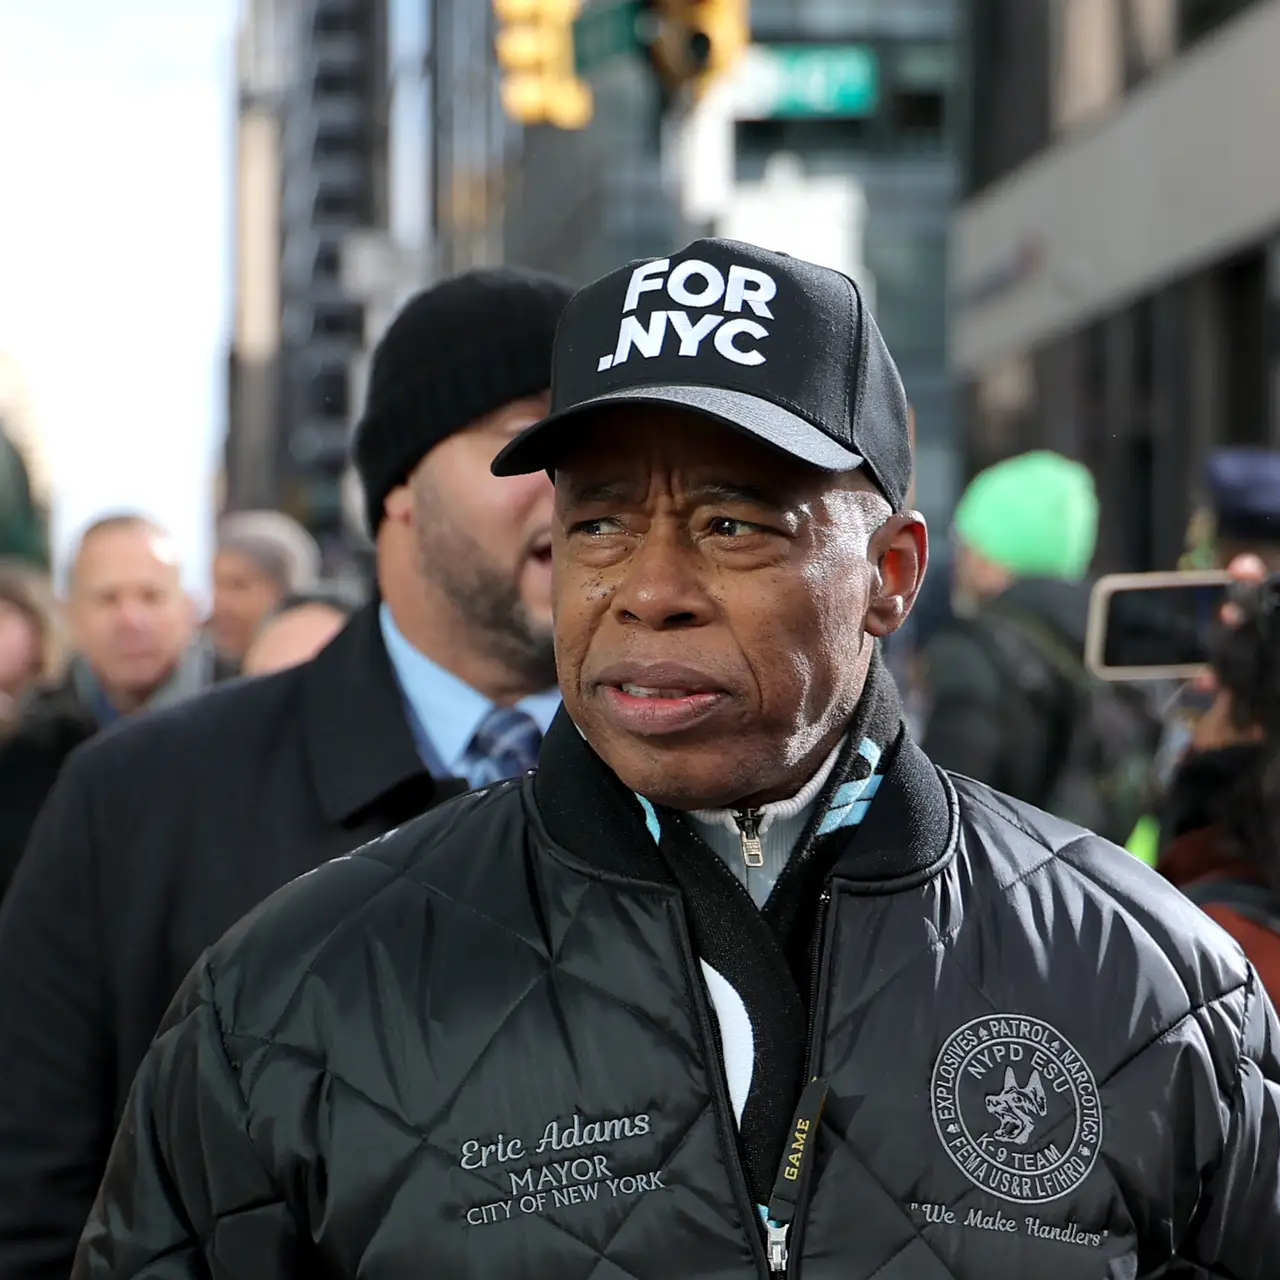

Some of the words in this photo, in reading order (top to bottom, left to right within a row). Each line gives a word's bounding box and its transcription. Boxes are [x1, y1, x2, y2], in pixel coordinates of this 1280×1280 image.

[622, 258, 777, 320] FOR
[596, 310, 770, 372] .NYC
[989, 1020, 1050, 1047] PATROL
[935, 1029, 979, 1120] EXPLOSIVES
[967, 1045, 1023, 1080] NYPD
[1030, 1052, 1070, 1093] ESU
[1059, 1050, 1100, 1144] NARCOTICS
[460, 1134, 525, 1170] Eric
[536, 1114, 651, 1153] Adams
[784, 1118, 810, 1180] GAME
[948, 1138, 986, 1182] FEMA
[989, 1175, 1032, 1198] US&R
[1035, 1155, 1087, 1198] LF/HRD
[976, 1133, 1008, 1162] K-9
[1011, 1143, 1062, 1171] TEAM
[466, 1200, 512, 1225] CITY
[520, 1193, 547, 1214] OF
[551, 1182, 599, 1208] NEW
[605, 1170, 665, 1197] YORK
[509, 1155, 612, 1195] MAYOR
[963, 1208, 1018, 1233] Make
